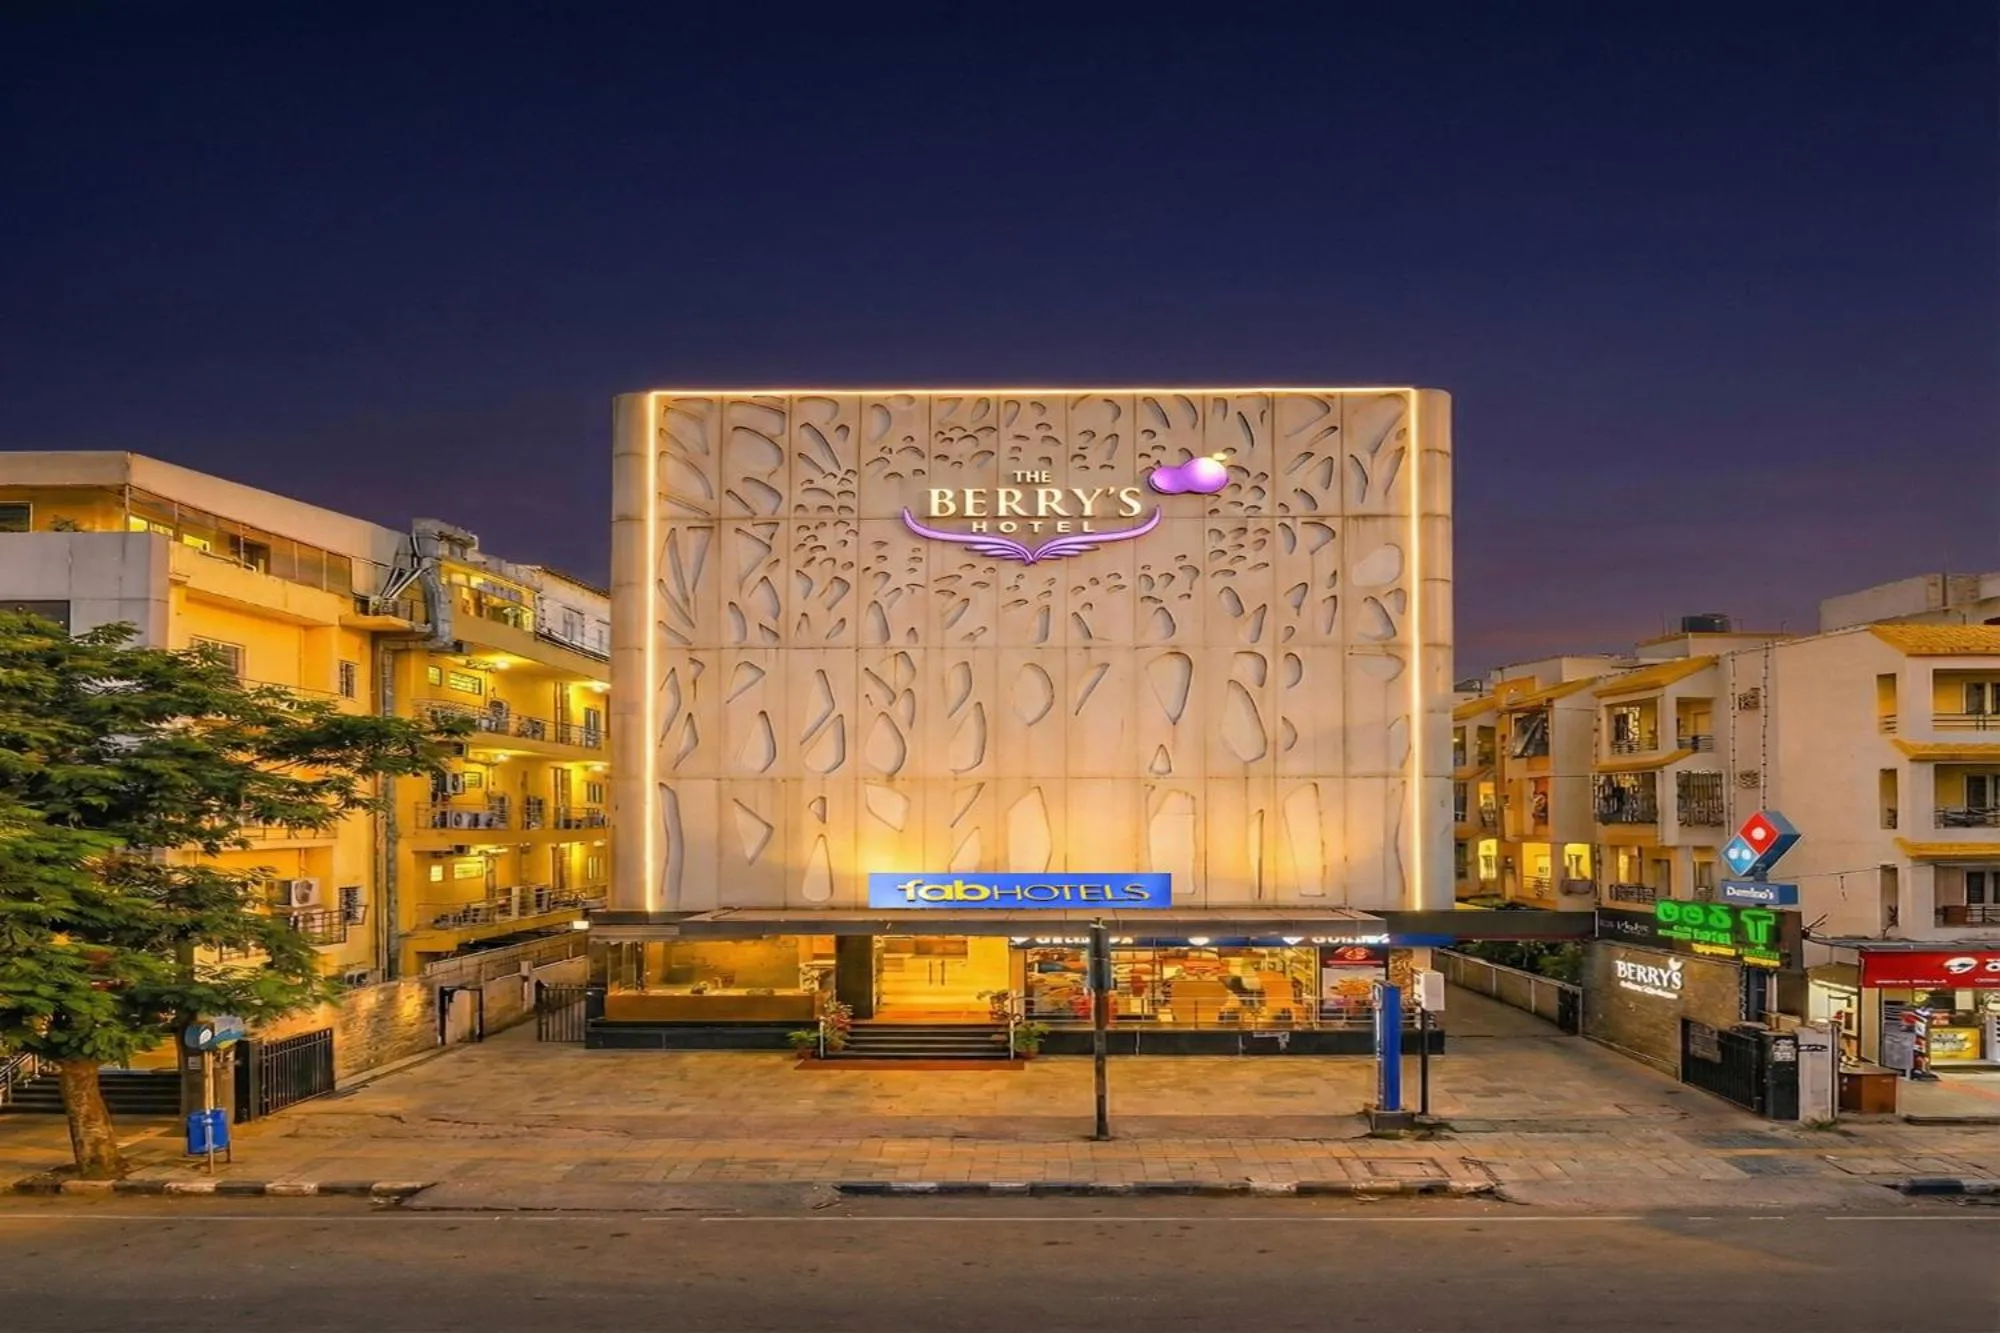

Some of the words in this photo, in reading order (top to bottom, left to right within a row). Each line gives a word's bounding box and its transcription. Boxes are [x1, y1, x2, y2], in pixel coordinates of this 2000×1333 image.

[1013, 470, 1052, 483] THE
[927, 487, 1143, 517] BERRY'S
[971, 520, 1096, 533] HOTEL
